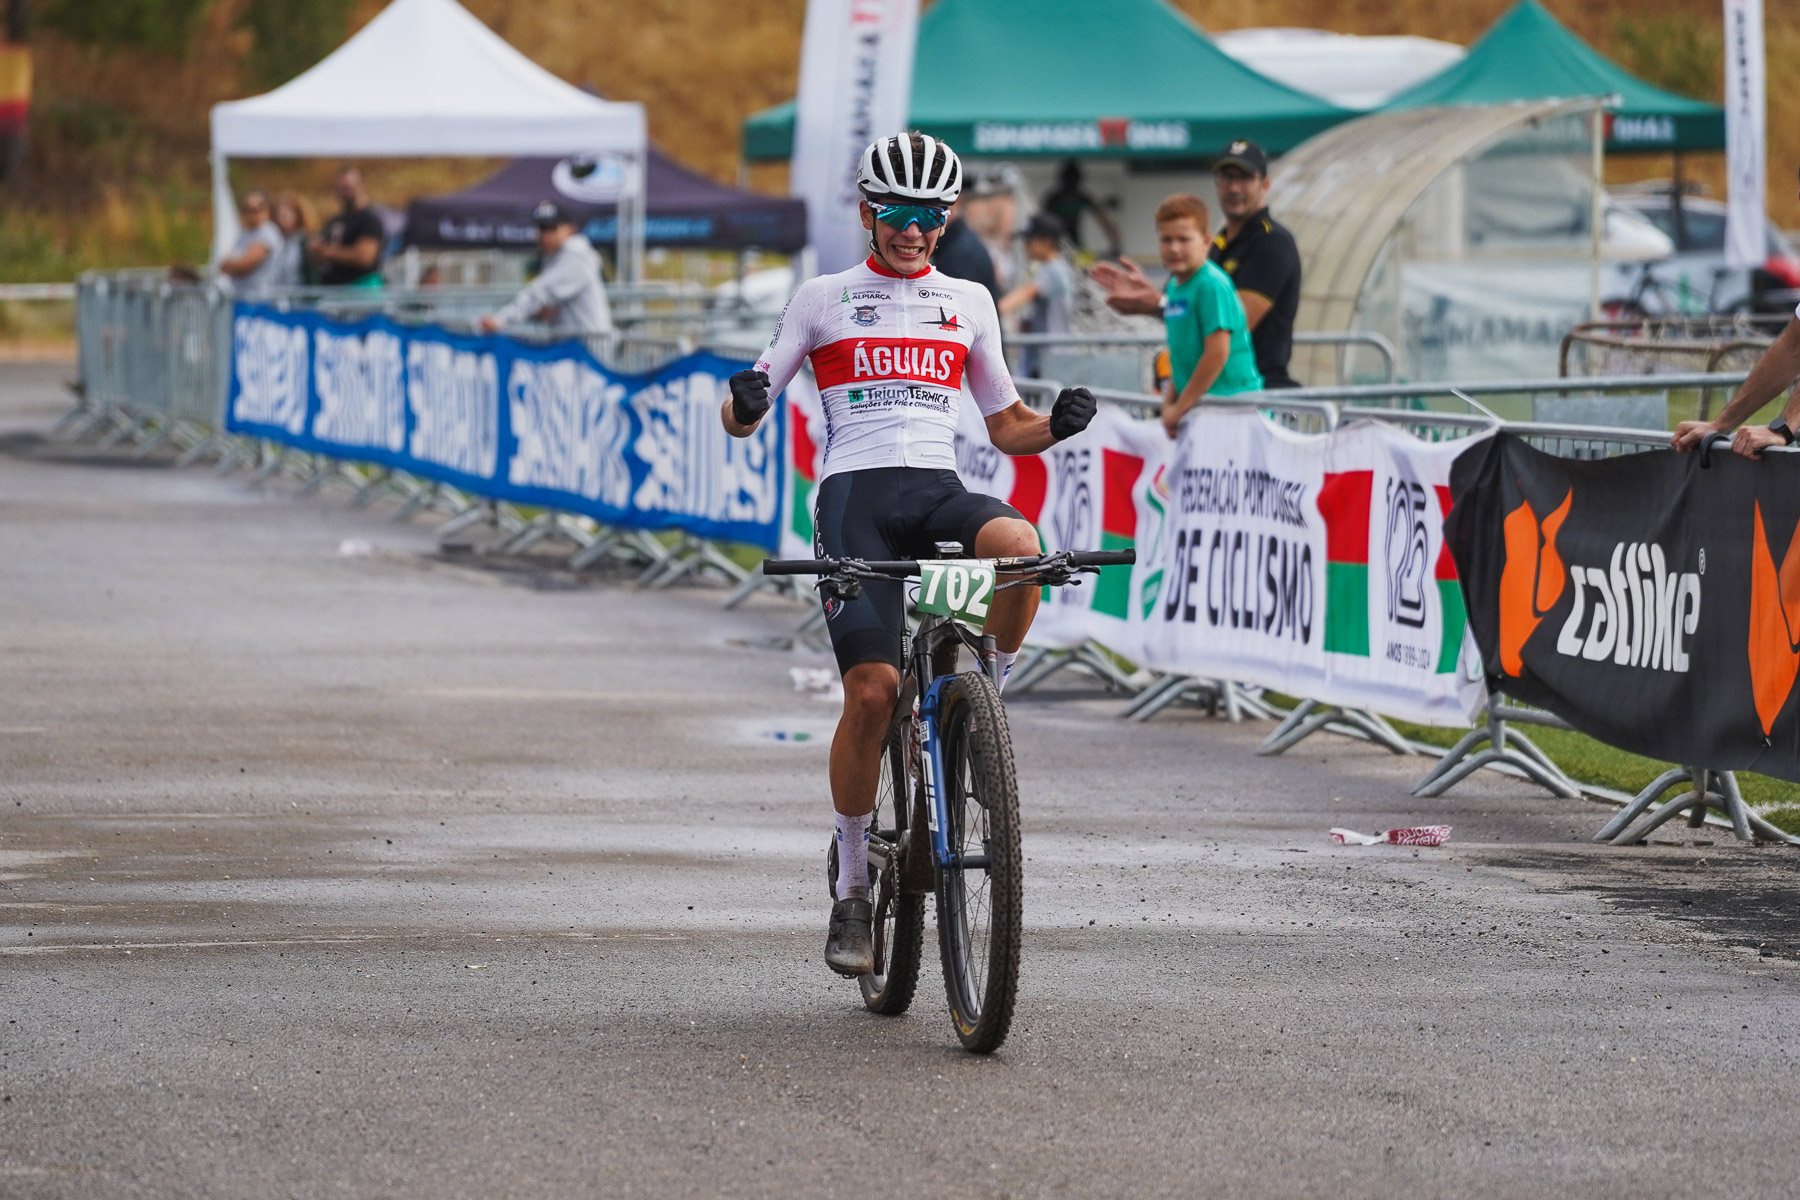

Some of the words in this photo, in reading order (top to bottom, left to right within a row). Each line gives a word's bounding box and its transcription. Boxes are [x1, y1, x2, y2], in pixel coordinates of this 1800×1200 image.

[932, 291, 953, 301] PACTO
[854, 341, 955, 381] ÁGUIAS
[1385, 477, 1428, 630] 125
[922, 565, 993, 619] 702
[1165, 529, 1201, 622] DE
[1207, 531, 1313, 645] CICLISMO
